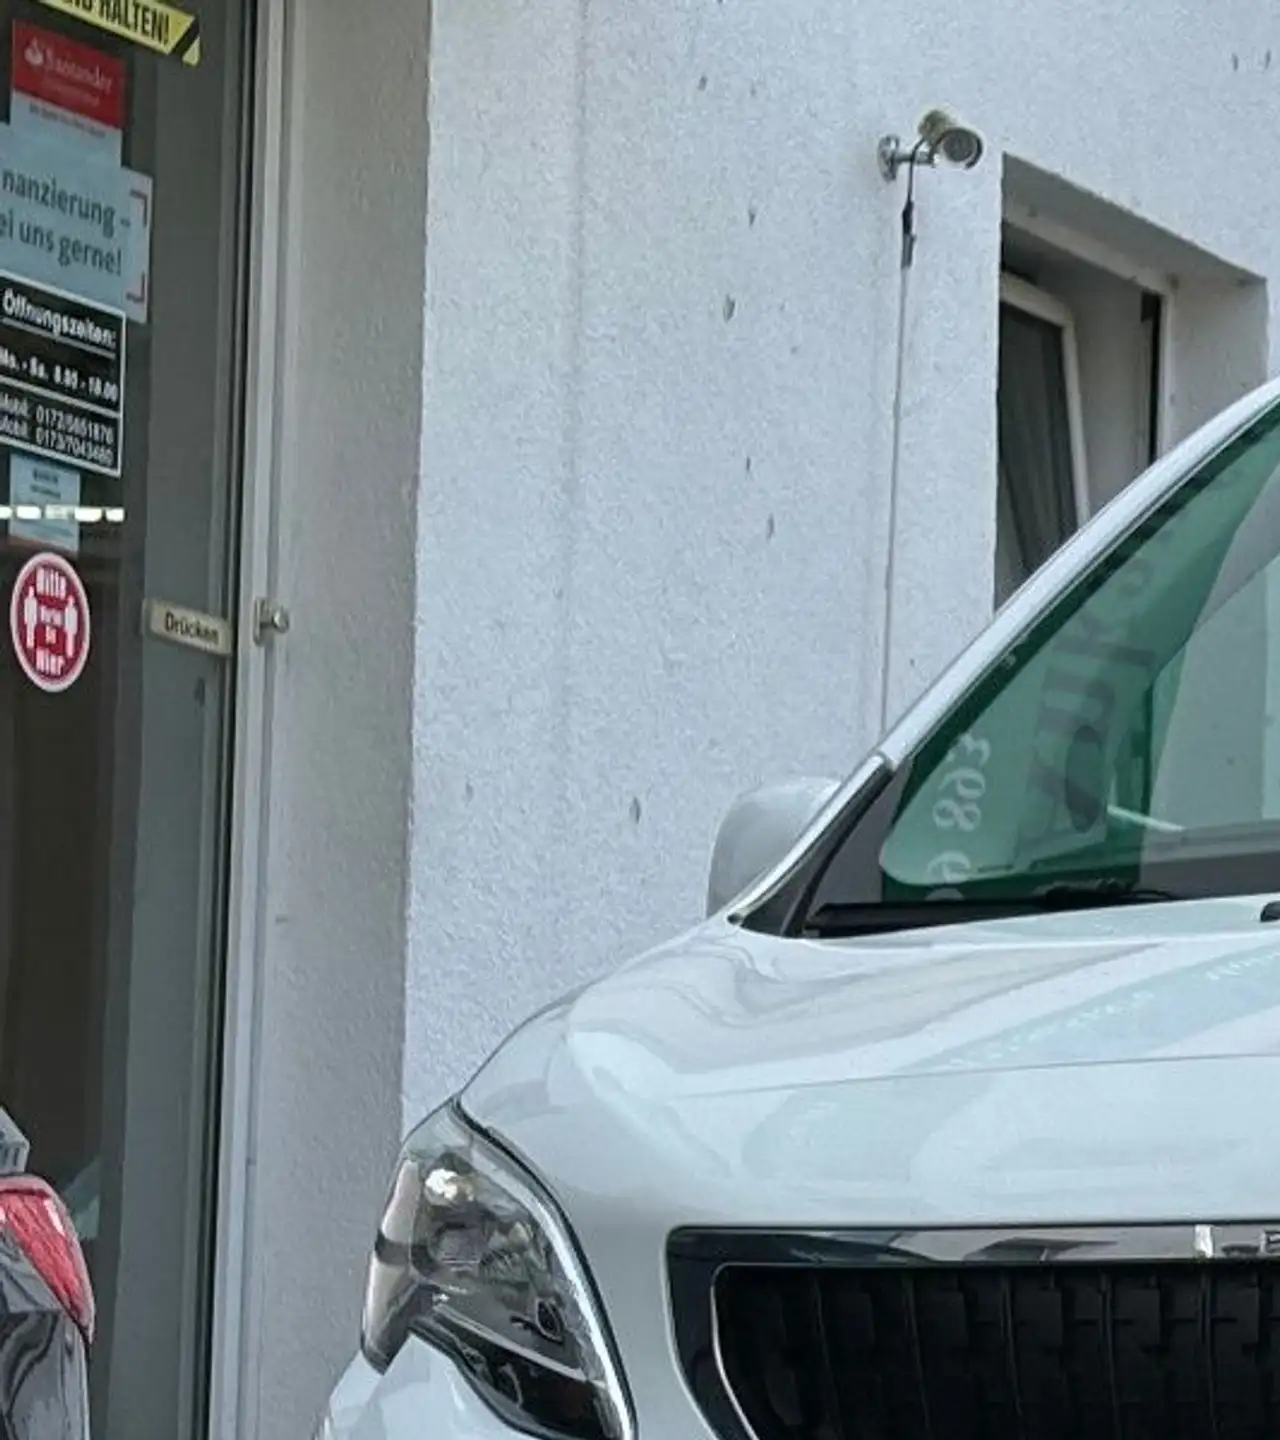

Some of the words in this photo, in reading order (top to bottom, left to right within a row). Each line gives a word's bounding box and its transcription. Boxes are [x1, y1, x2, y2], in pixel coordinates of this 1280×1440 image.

[99, 0, 169, 46] HALTEN!
[19, 220, 54, 252] uns
[58, 235, 121, 276] gerne!
[164, 611, 219, 645] Drücken
